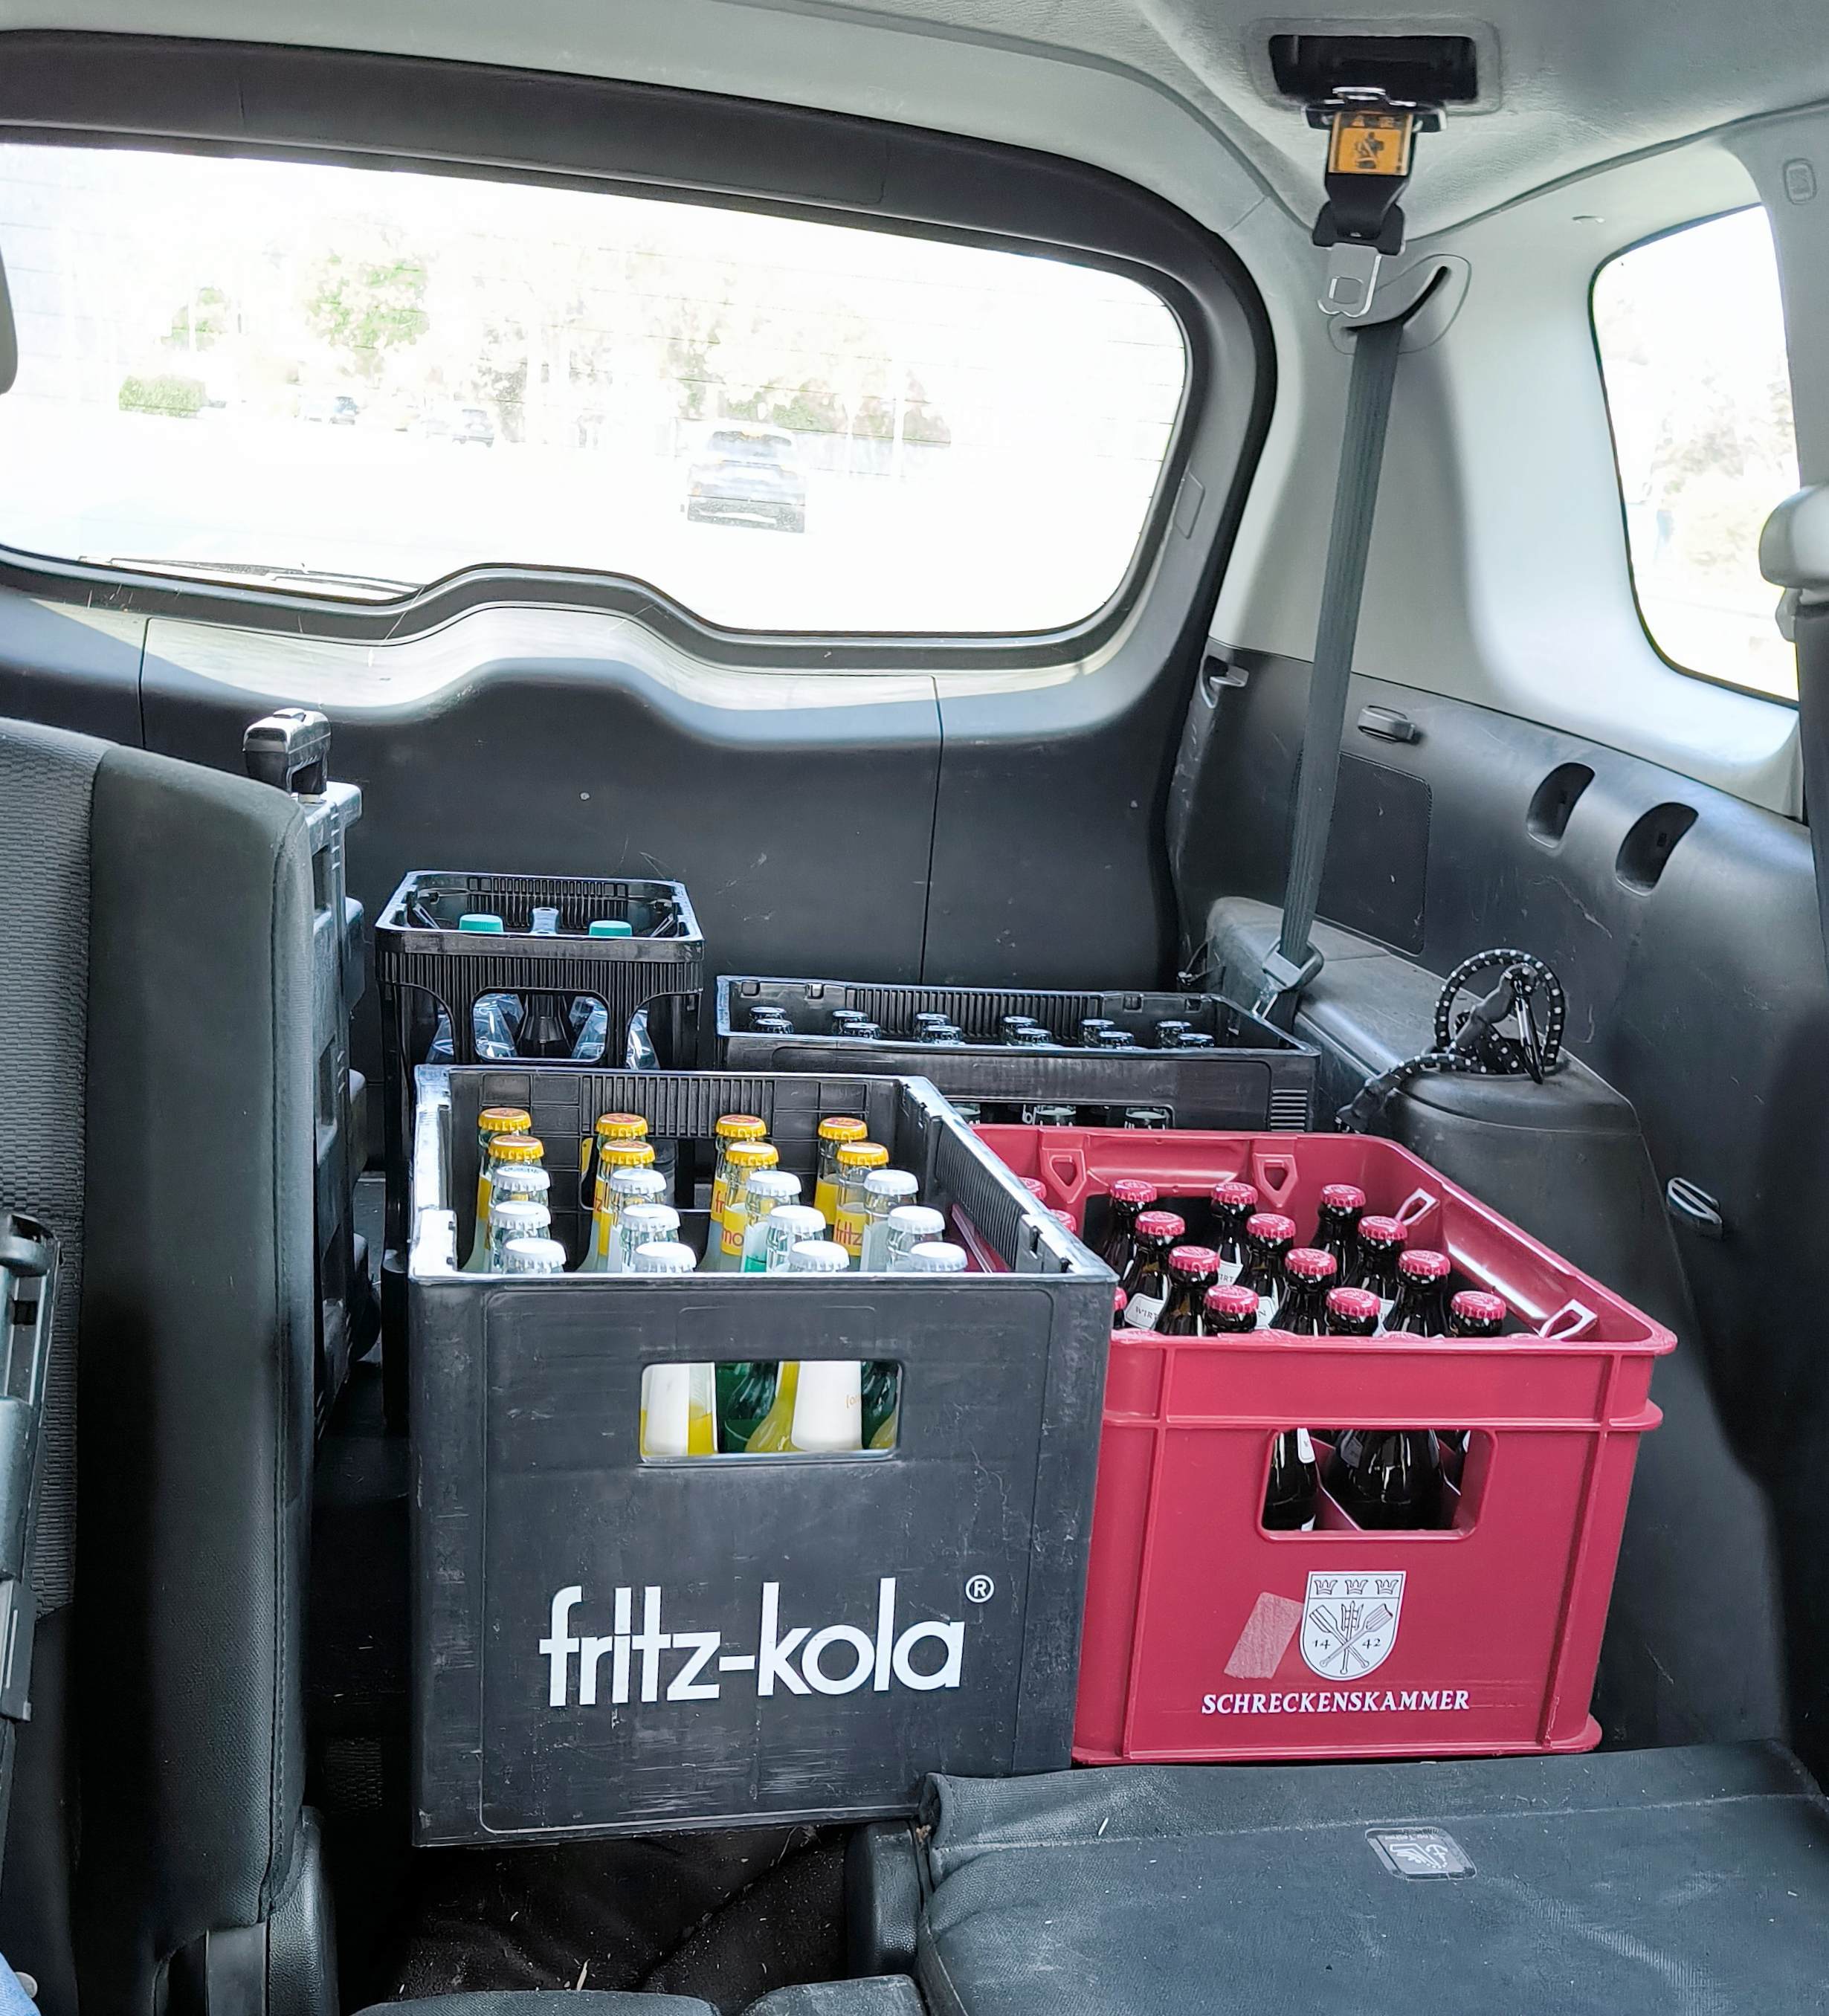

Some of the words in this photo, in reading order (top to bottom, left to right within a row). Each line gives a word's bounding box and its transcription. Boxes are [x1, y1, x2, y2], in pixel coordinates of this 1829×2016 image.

[836, 1218, 862, 1245] fritz
[538, 1577, 965, 1707] fritz-kola
[1312, 1639, 1331, 1650] 14
[1362, 1638, 1381, 1650] 42
[1201, 1690, 1471, 1715] SCHRECKENSKAMMER
